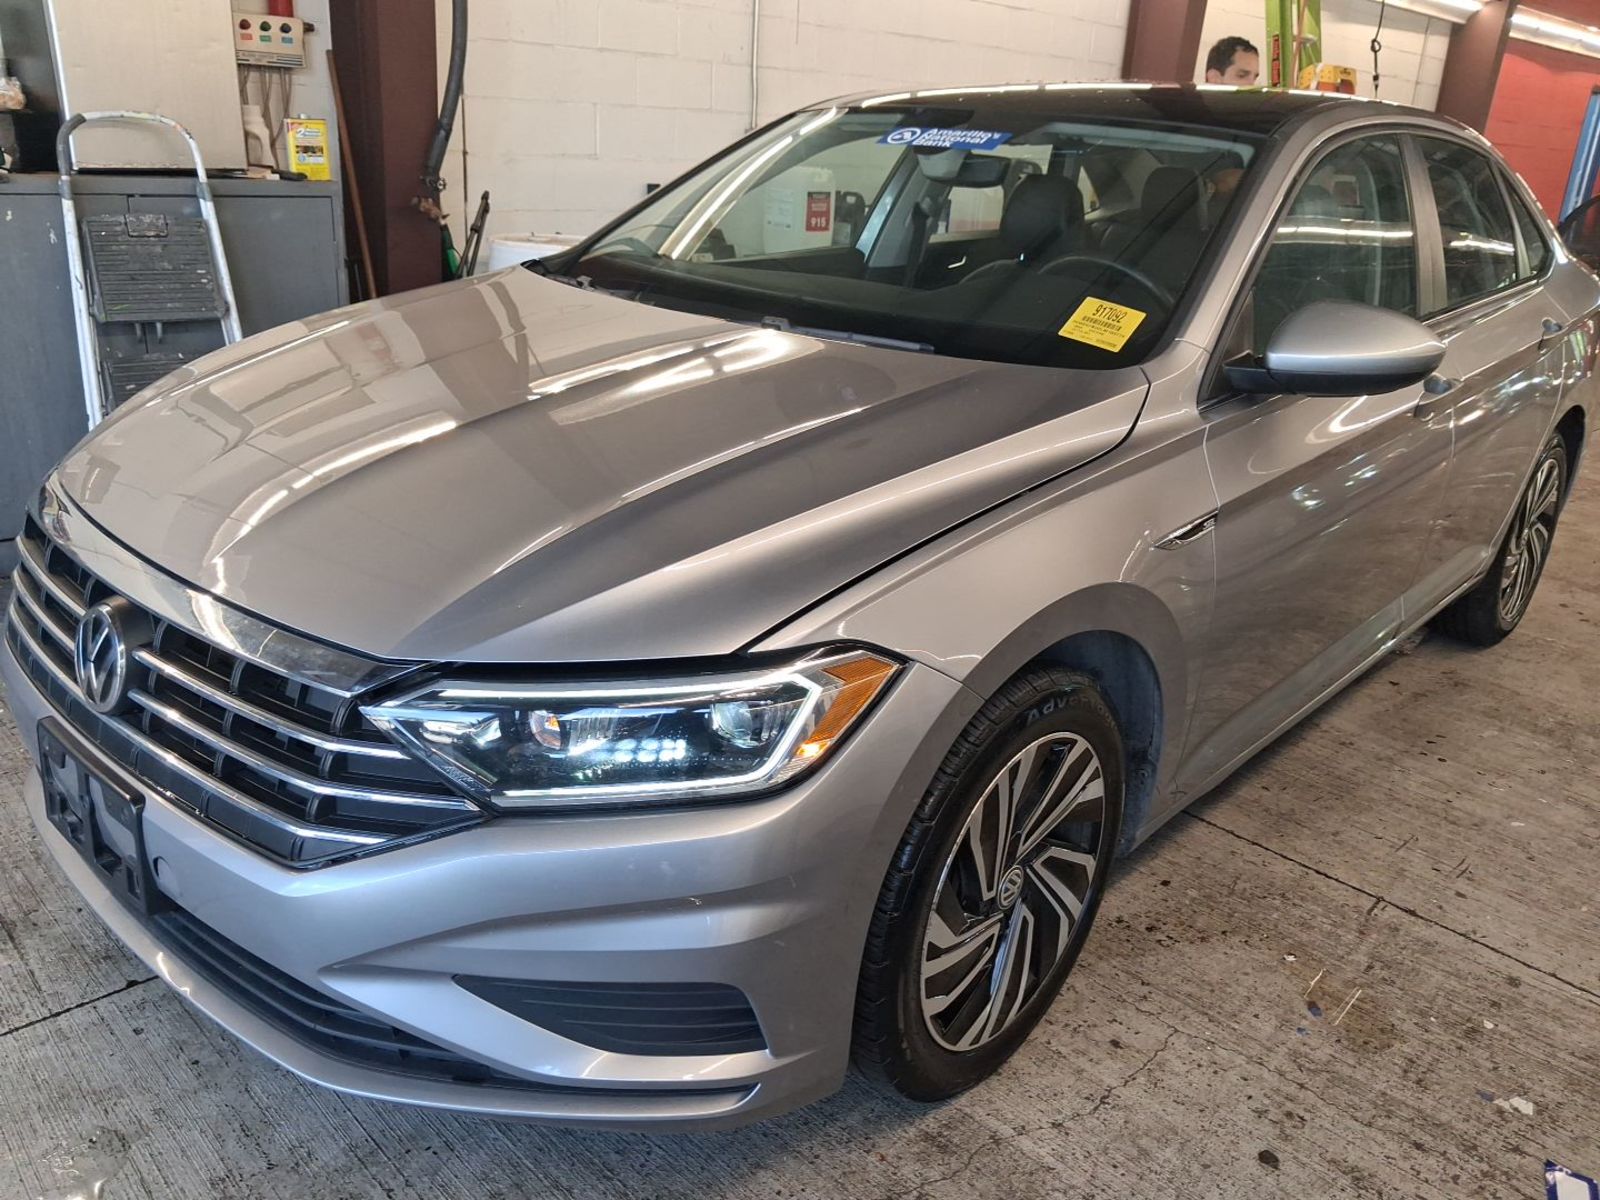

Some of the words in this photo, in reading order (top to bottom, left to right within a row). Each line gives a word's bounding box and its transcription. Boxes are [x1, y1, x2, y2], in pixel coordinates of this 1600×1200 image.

[912, 138, 952, 147] Bank
[918, 132, 989, 144] National
[1092, 304, 1128, 323] 917092
